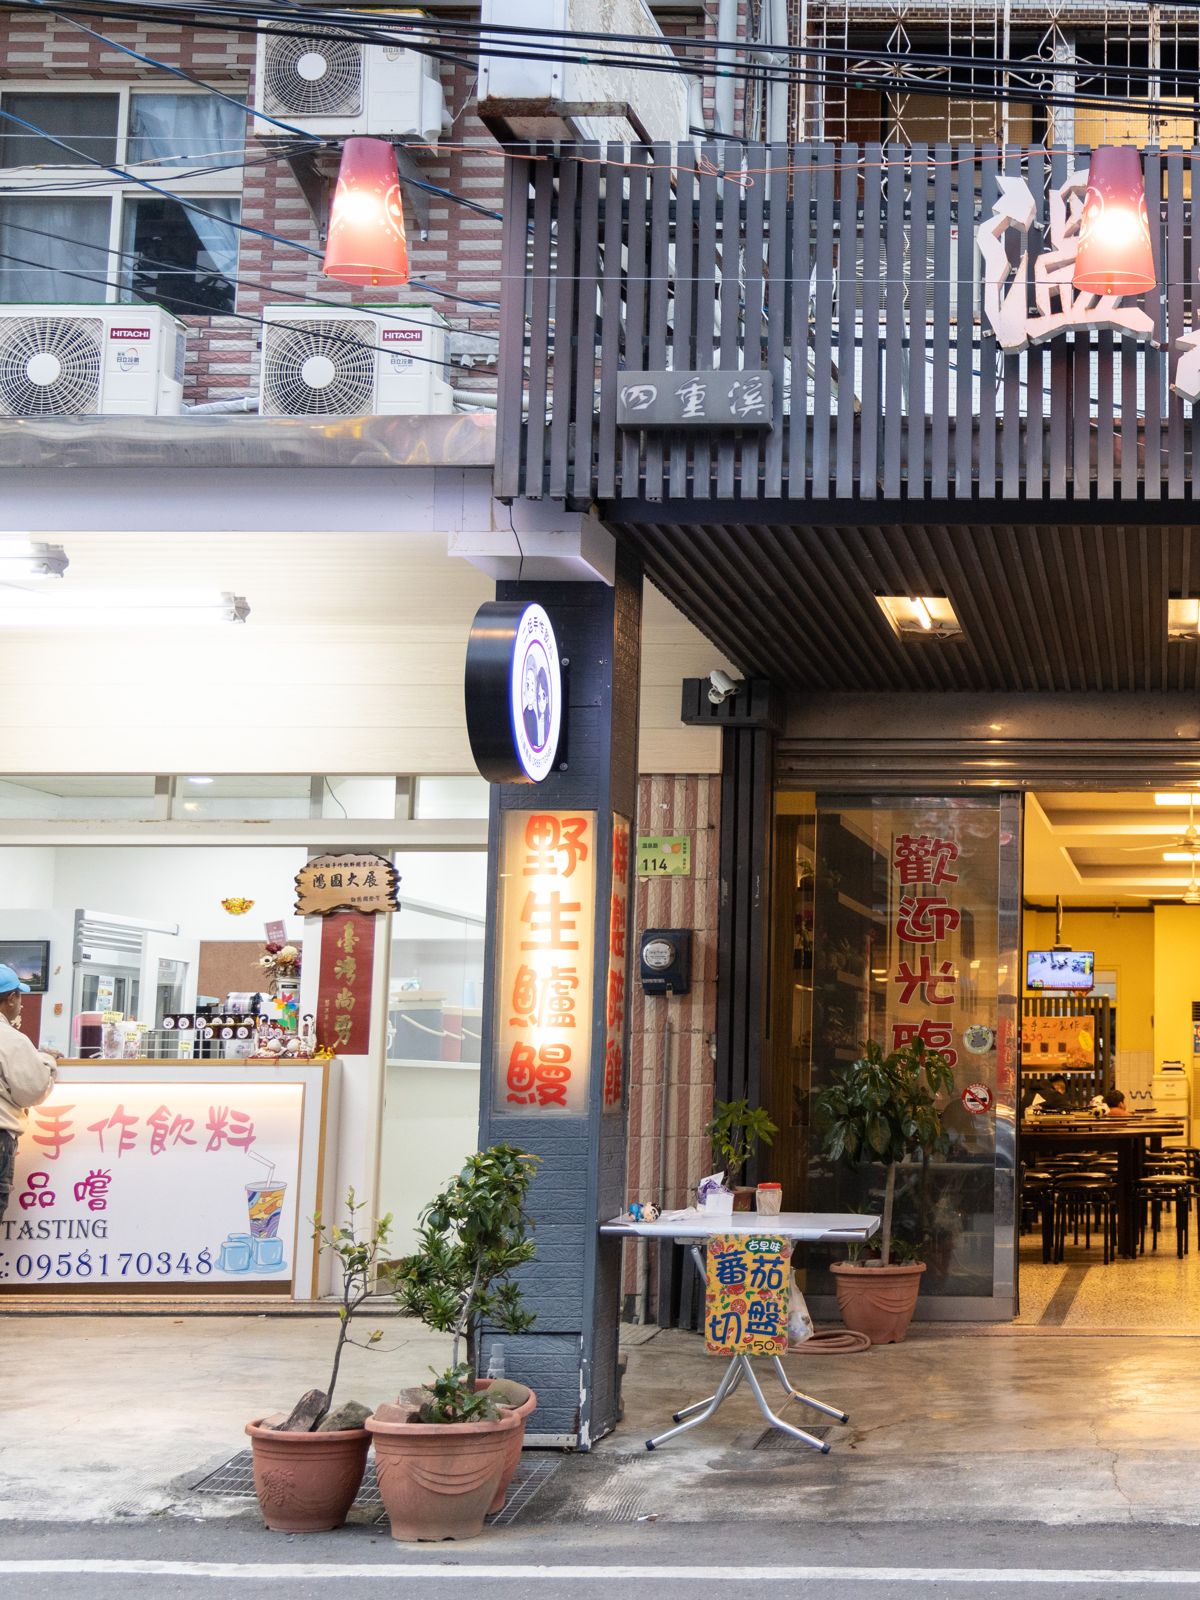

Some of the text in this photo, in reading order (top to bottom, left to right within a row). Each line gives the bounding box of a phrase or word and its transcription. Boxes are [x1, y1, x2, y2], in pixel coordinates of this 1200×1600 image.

[112, 330, 149, 338] HITACHI
[620, 376, 766, 418] 四重溪
[643, 858, 668, 871] 114
[506, 814, 589, 1107] 野生鱸鰻
[2, 1219, 109, 1241] TASTING
[748, 1239, 782, 1253] 古早味
[709, 1300, 782, 1345] 切盤
